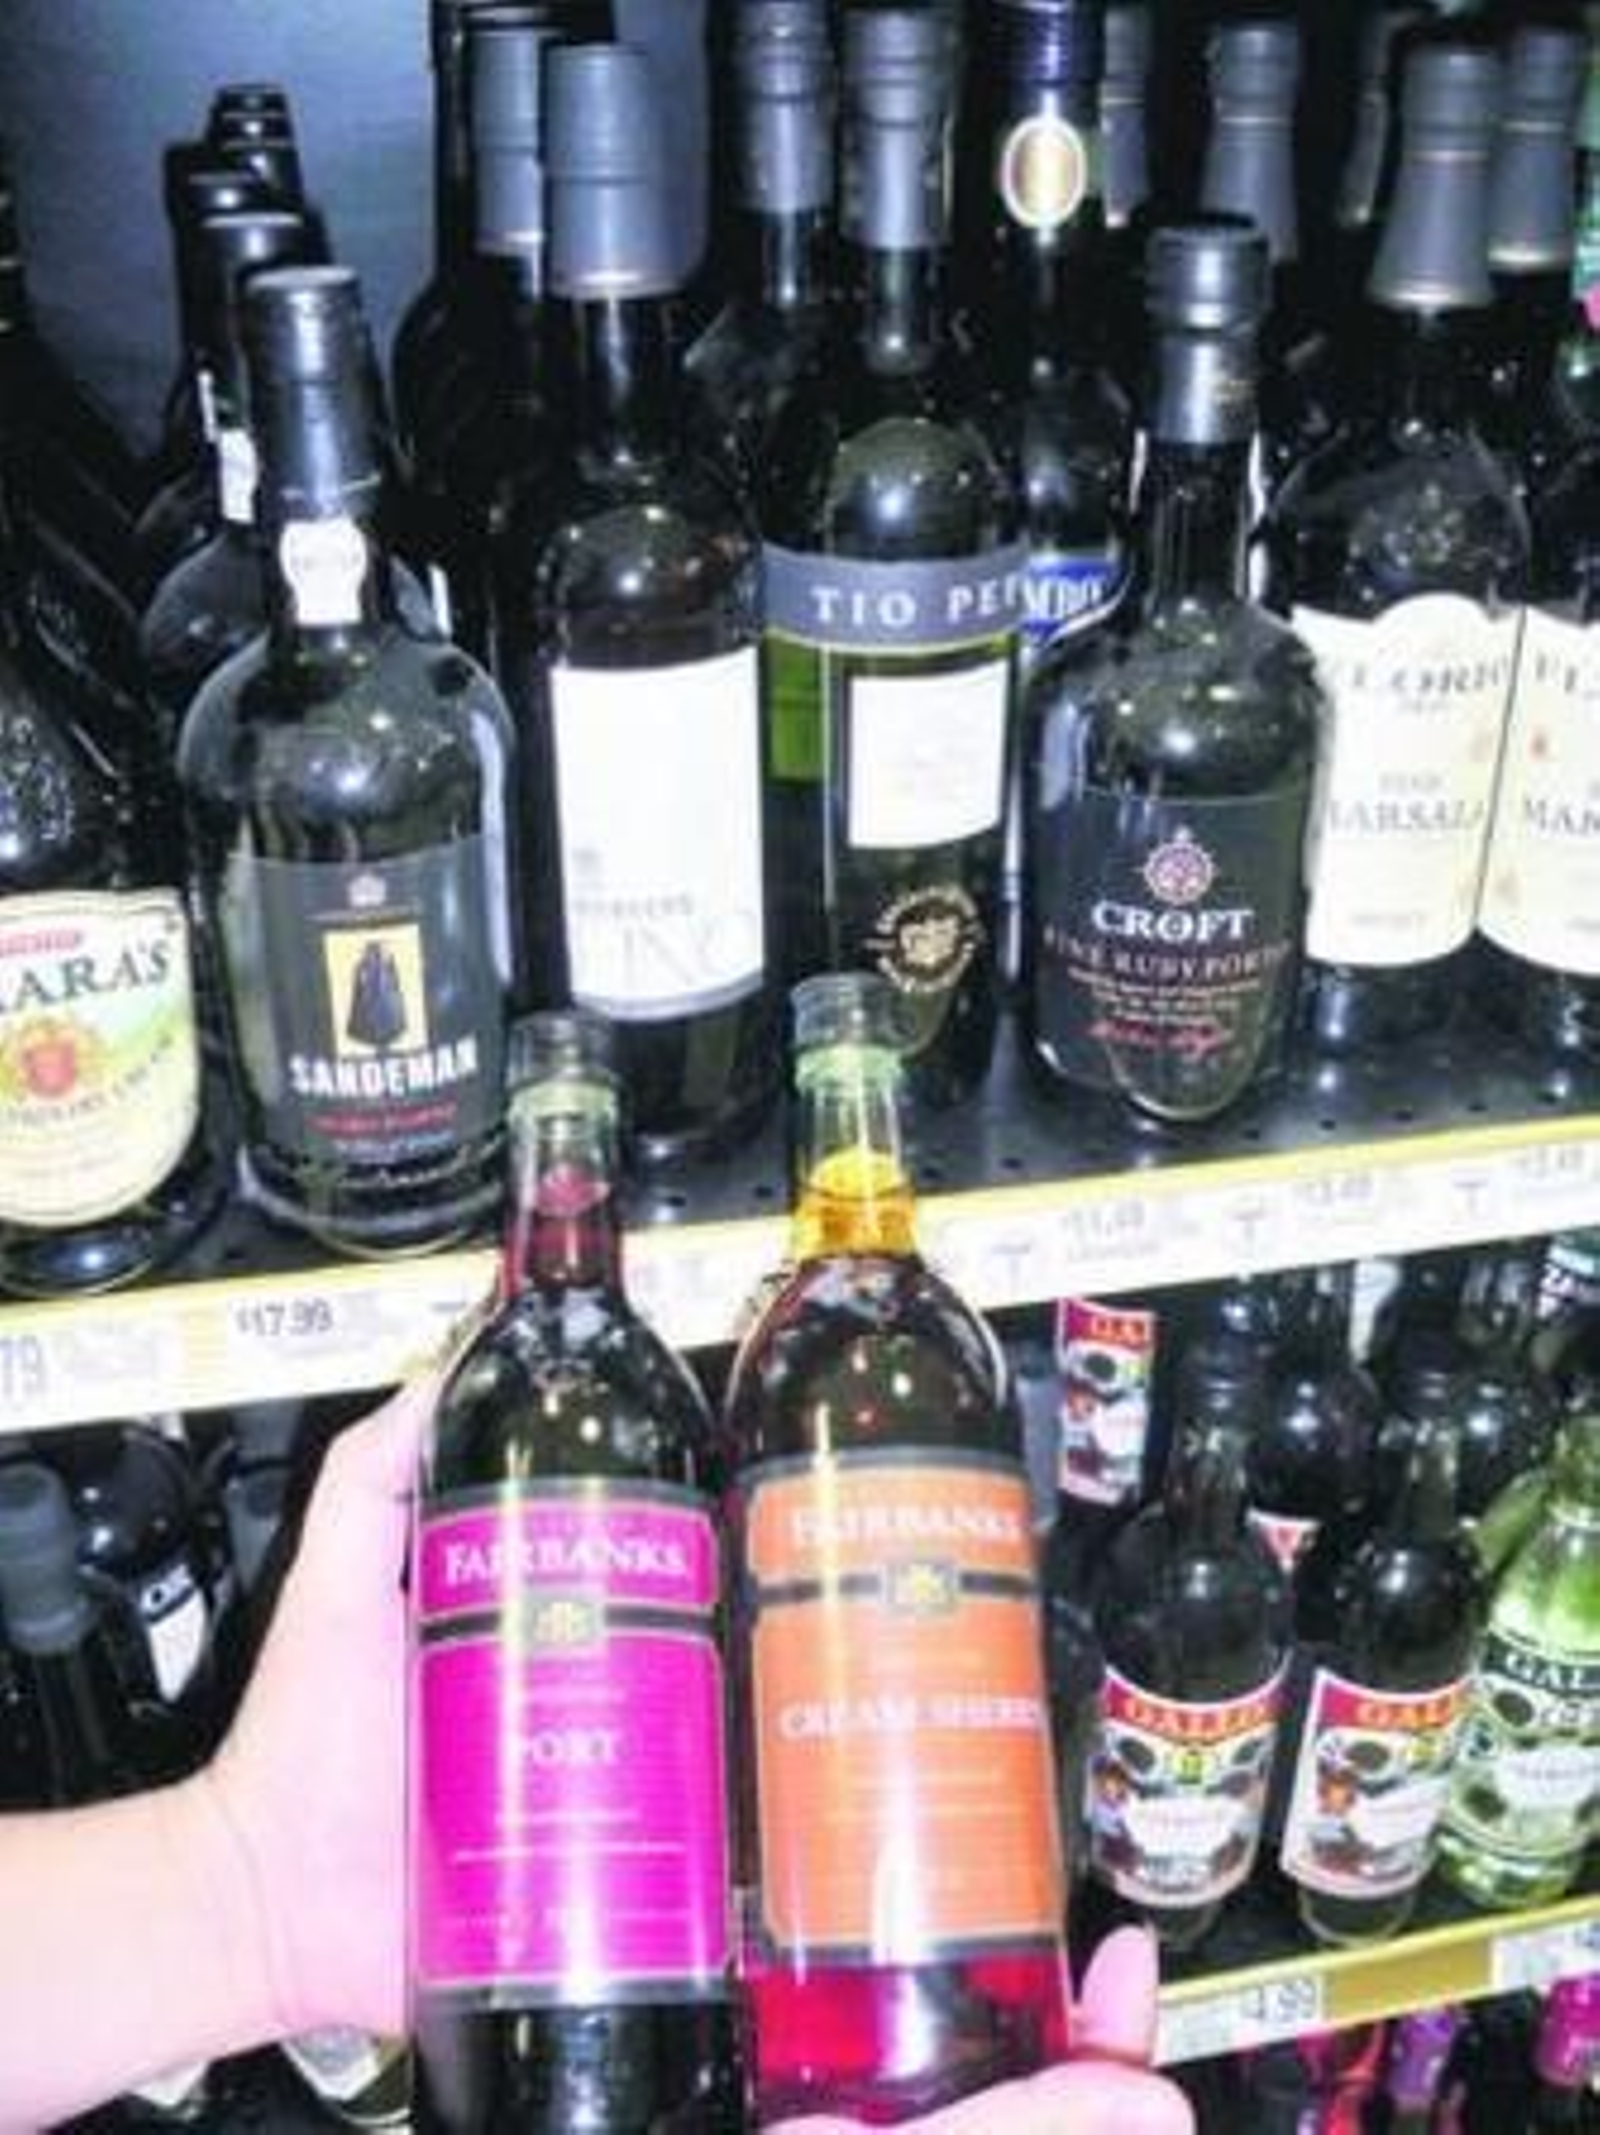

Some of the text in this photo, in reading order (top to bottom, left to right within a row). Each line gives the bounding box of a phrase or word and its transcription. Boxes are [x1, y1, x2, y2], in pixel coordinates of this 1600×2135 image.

[810, 584, 917, 628] TIO
[1091, 902, 1254, 941] CROFT
[290, 1036, 478, 1098] SANDEMAN
[444, 1536, 690, 1586] FAIRBANKS
